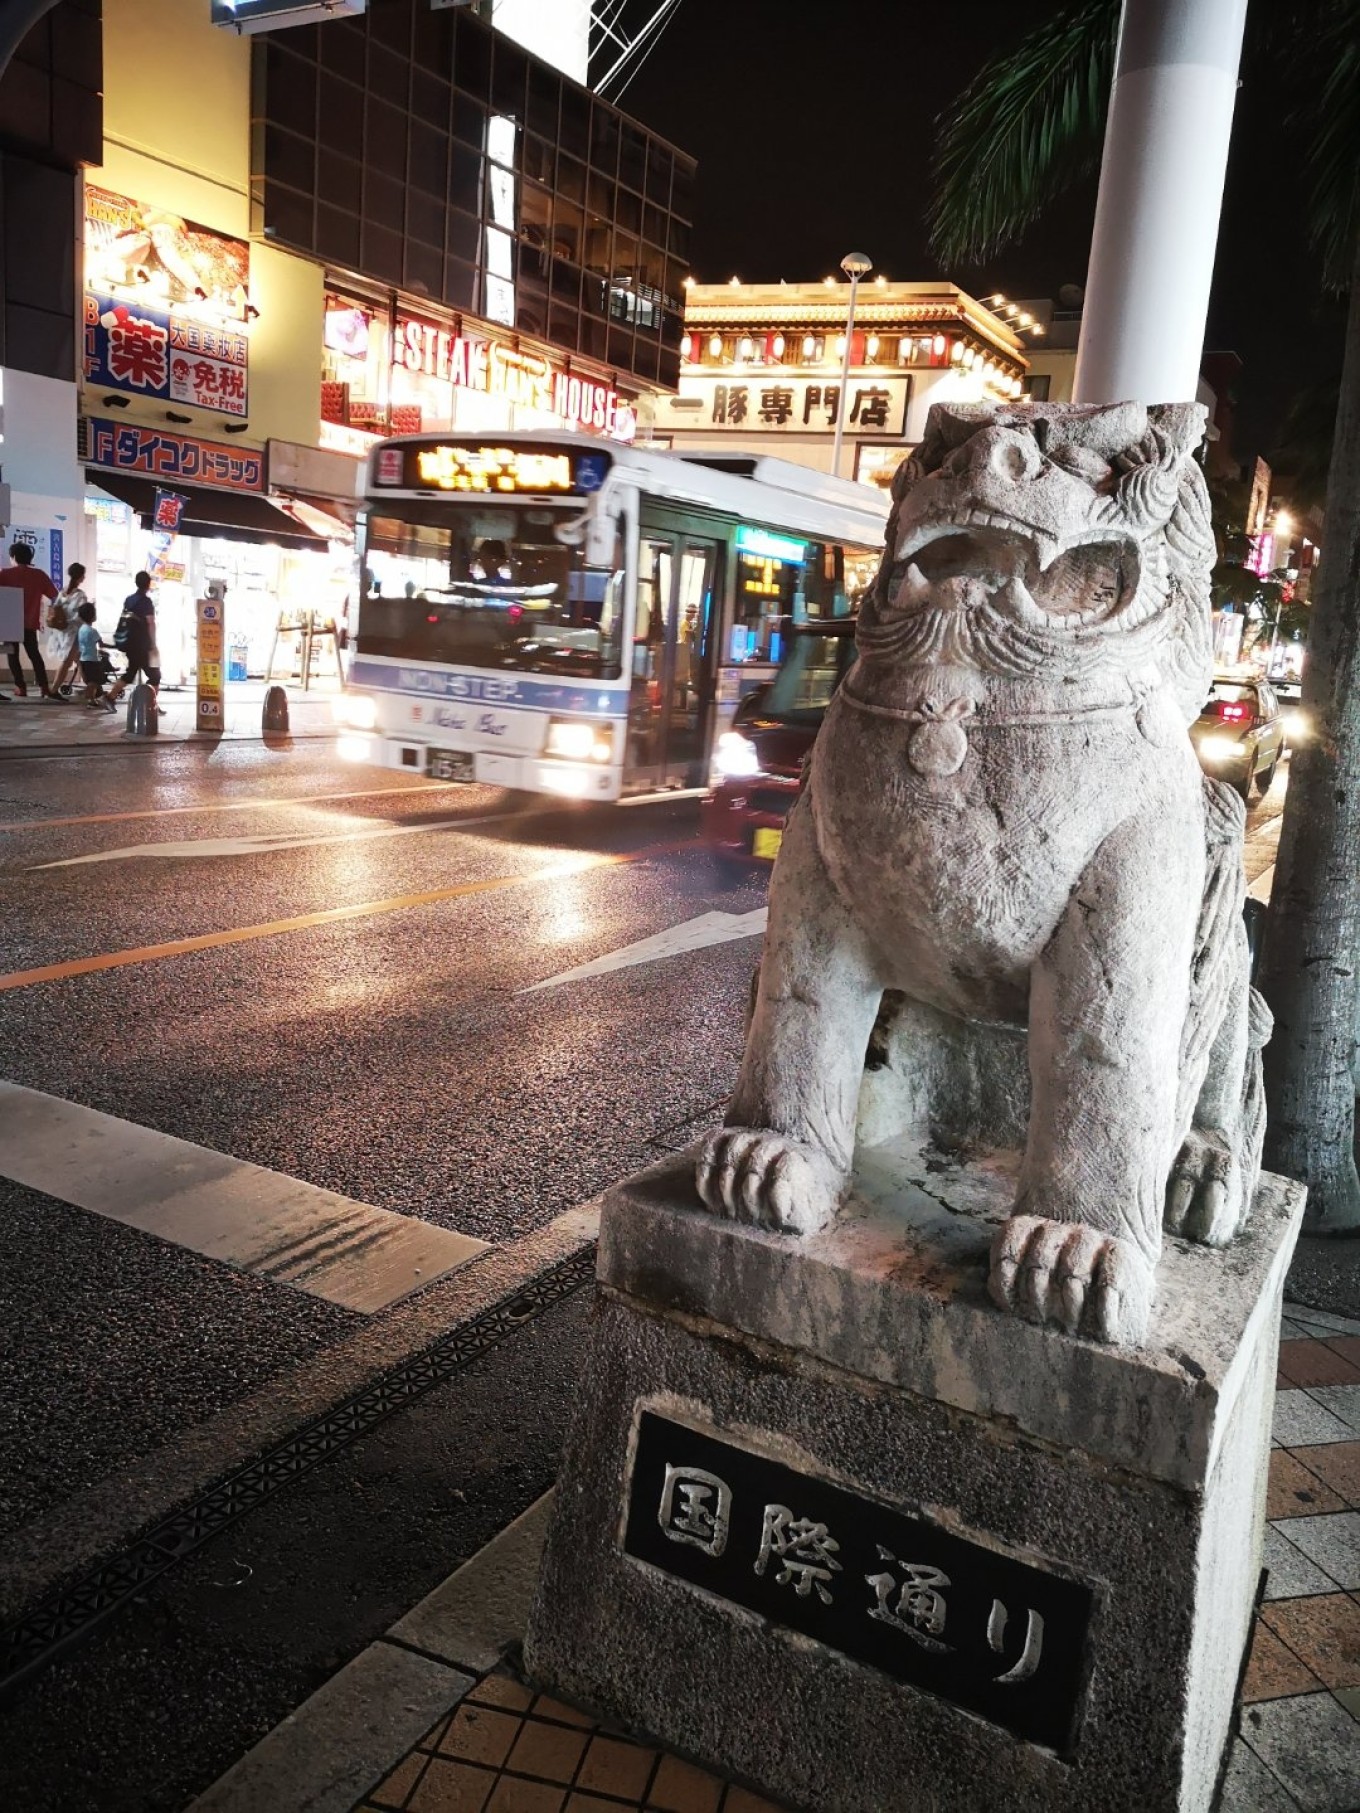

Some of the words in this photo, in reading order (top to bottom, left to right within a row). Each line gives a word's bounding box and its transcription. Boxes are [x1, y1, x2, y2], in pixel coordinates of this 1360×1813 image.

[108, 314, 168, 390] 薬
[193, 361, 245, 400] 免税
[405, 321, 488, 390] STEAK
[555, 372, 618, 432] HOUSE
[195, 390, 244, 413] Tax-Free
[116, 428, 262, 485] ダイコクドラッグ
[659, 1461, 1044, 1683] 国際通り
